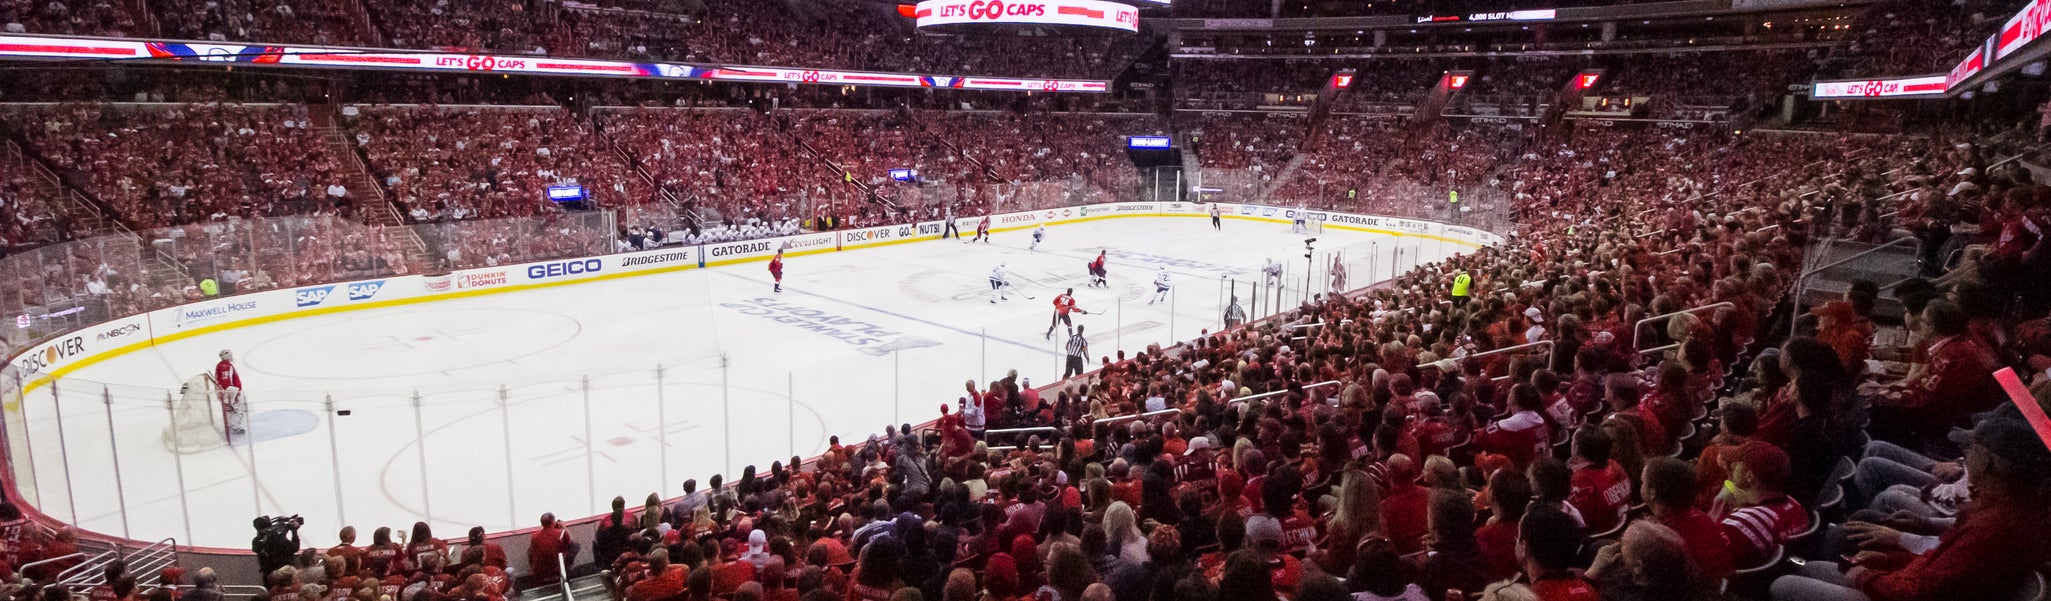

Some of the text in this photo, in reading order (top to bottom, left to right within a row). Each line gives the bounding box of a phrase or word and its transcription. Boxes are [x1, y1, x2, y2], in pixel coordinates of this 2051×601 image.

[940, 0, 1045, 19] LET'S GO CAPS
[1488, 12, 1505, 20] SLOT
[1116, 10, 1132, 23] LET'S
[436, 54, 525, 70] LET'S GO CAPS
[803, 70, 820, 83] GO
[1043, 80, 1059, 92] GO
[1847, 85, 1863, 94] LET'S
[1865, 80, 1883, 97] GO
[1116, 204, 1153, 212] BRIDGESTONE
[1002, 214, 1036, 224] HONDA
[1332, 215, 1379, 226] GATORADE
[846, 229, 890, 242] DISCOVER
[919, 223, 940, 235] NUTS!
[812, 237, 833, 246] LIGHT
[712, 241, 771, 257] GATORADE
[621, 251, 688, 267] BRIDGESTONE
[527, 258, 602, 279] GEICO
[471, 271, 508, 280] DUNKIN'
[472, 278, 507, 288] DONUTS
[297, 290, 328, 302] SAP
[350, 283, 379, 297] SAP
[185, 300, 257, 321] MAXWELL HOUSE
[22, 336, 85, 378] DISCOVER
